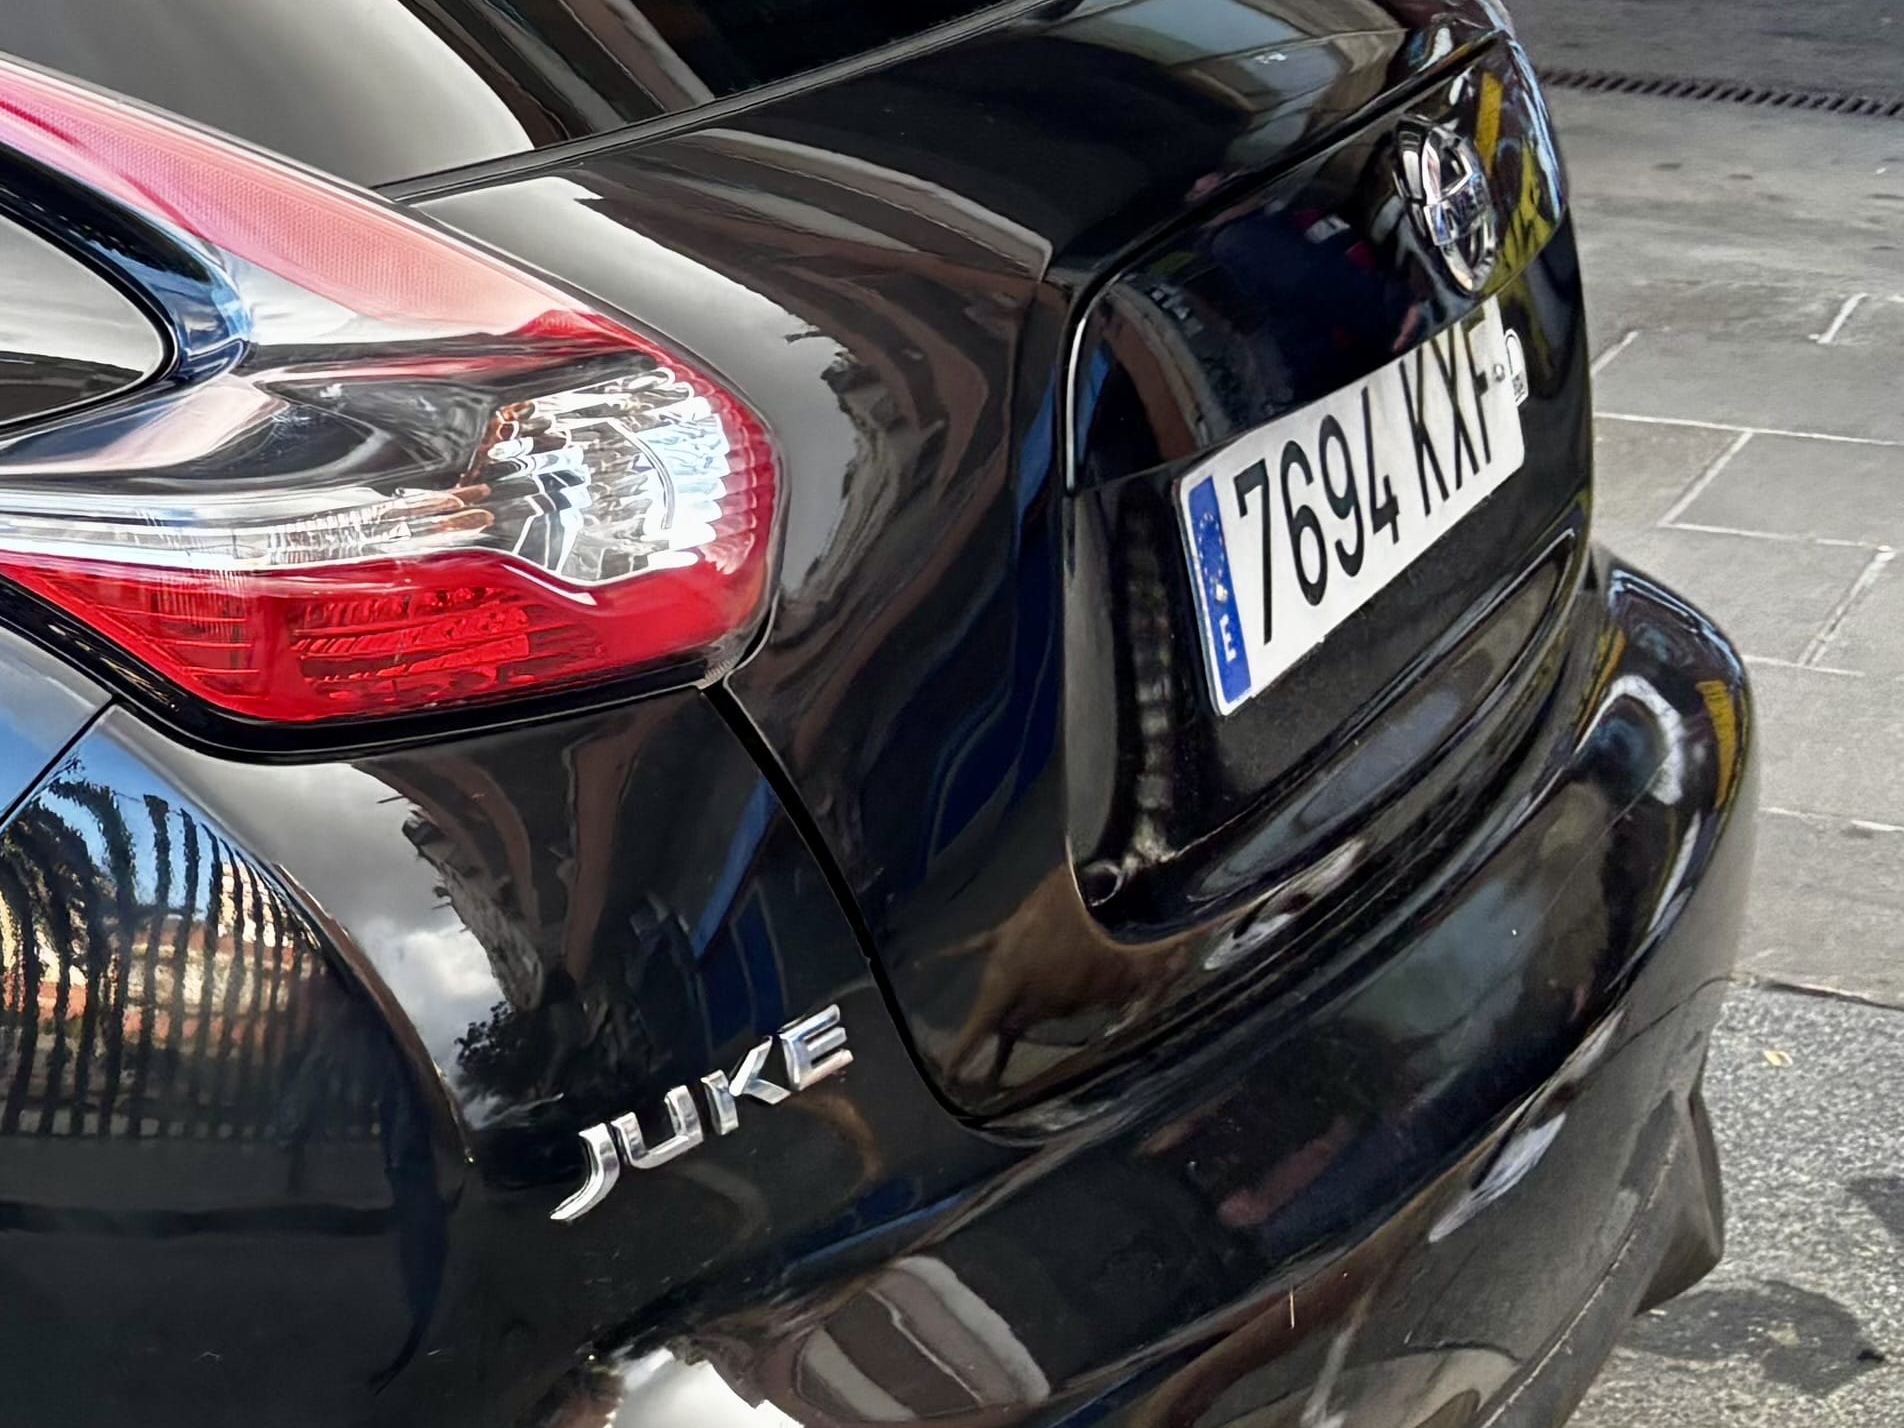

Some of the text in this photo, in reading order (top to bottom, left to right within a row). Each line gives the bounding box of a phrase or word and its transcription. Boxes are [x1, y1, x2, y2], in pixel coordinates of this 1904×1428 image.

[1234, 305, 1492, 647] 7694 KXF
[1219, 614, 1237, 662] E
[550, 1003, 854, 1220] JUKE
